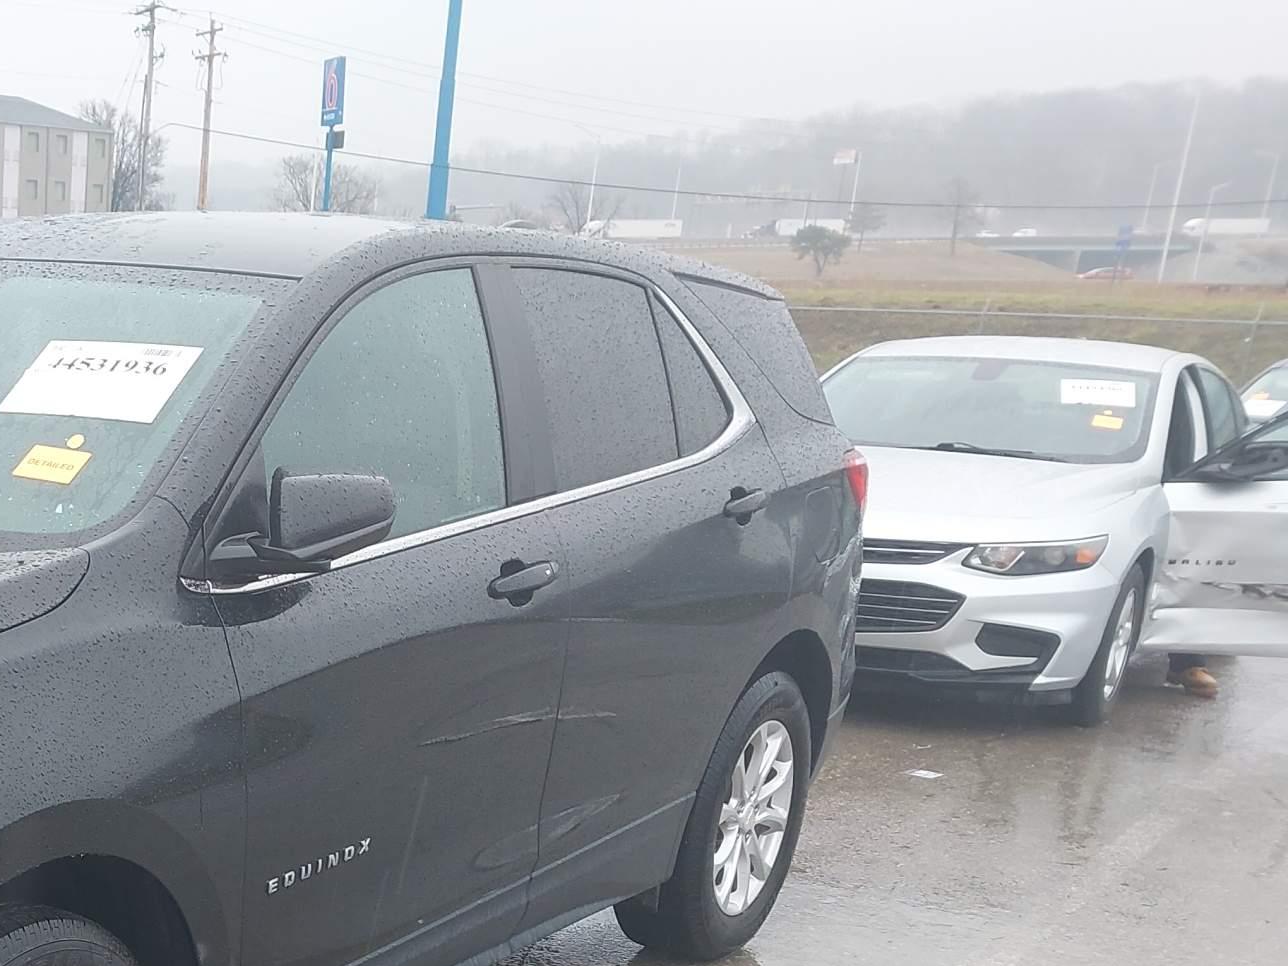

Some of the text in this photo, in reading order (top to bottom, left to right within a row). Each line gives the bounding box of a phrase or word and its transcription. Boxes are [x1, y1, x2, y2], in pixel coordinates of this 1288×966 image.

[325, 61, 338, 110] 6
[26, 457, 75, 472] DETAILED
[267, 837, 372, 895] EQUINOX
